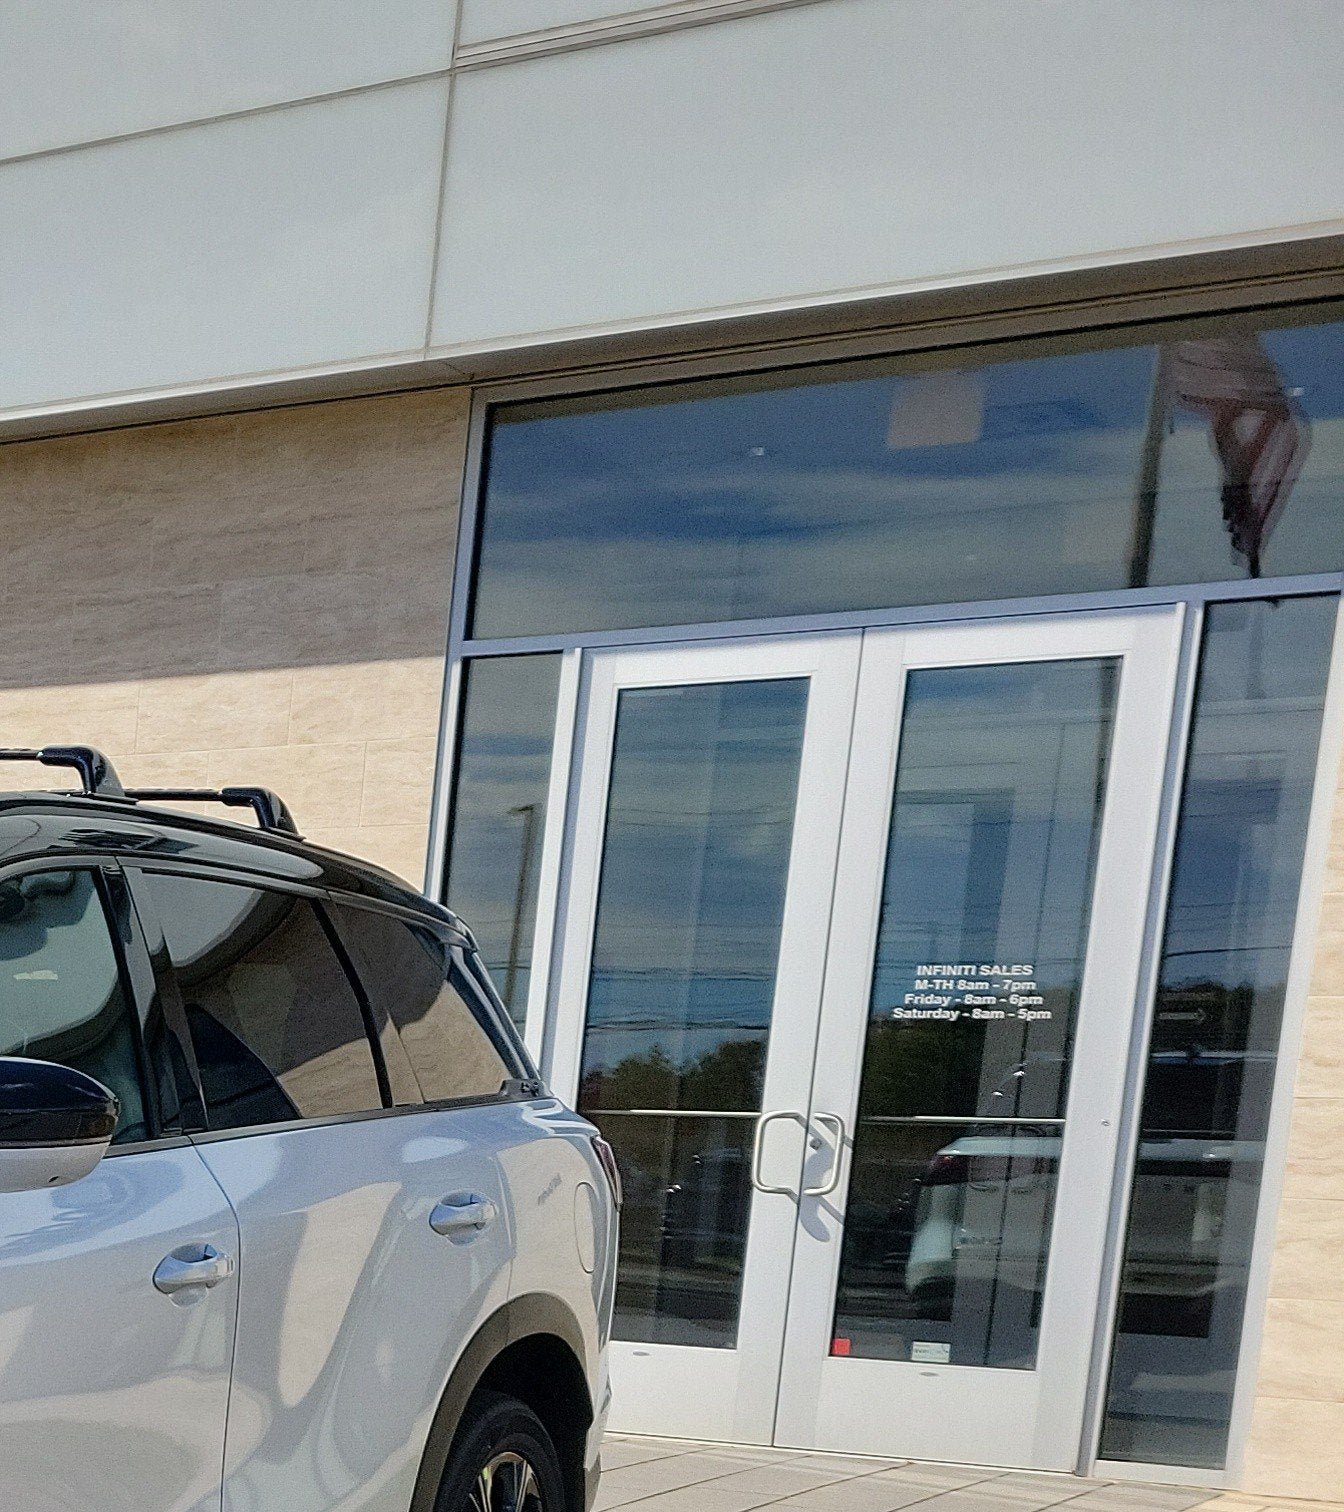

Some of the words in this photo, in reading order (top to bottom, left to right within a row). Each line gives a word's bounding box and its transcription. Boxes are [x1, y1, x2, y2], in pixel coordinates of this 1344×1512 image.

[917, 965, 977, 976] INFINITI
[979, 964, 1034, 976] SALES
[915, 979, 954, 990] M-TH
[957, 979, 989, 990] 8am
[1002, 979, 1037, 992] 7pm
[904, 993, 952, 1007] Friday
[964, 993, 997, 1005] 8am
[1009, 993, 1044, 1007] 6pm
[892, 1007, 960, 1022] Saturday
[972, 1008, 1005, 1019] 8am
[1017, 1008, 1052, 1022] 5pm
